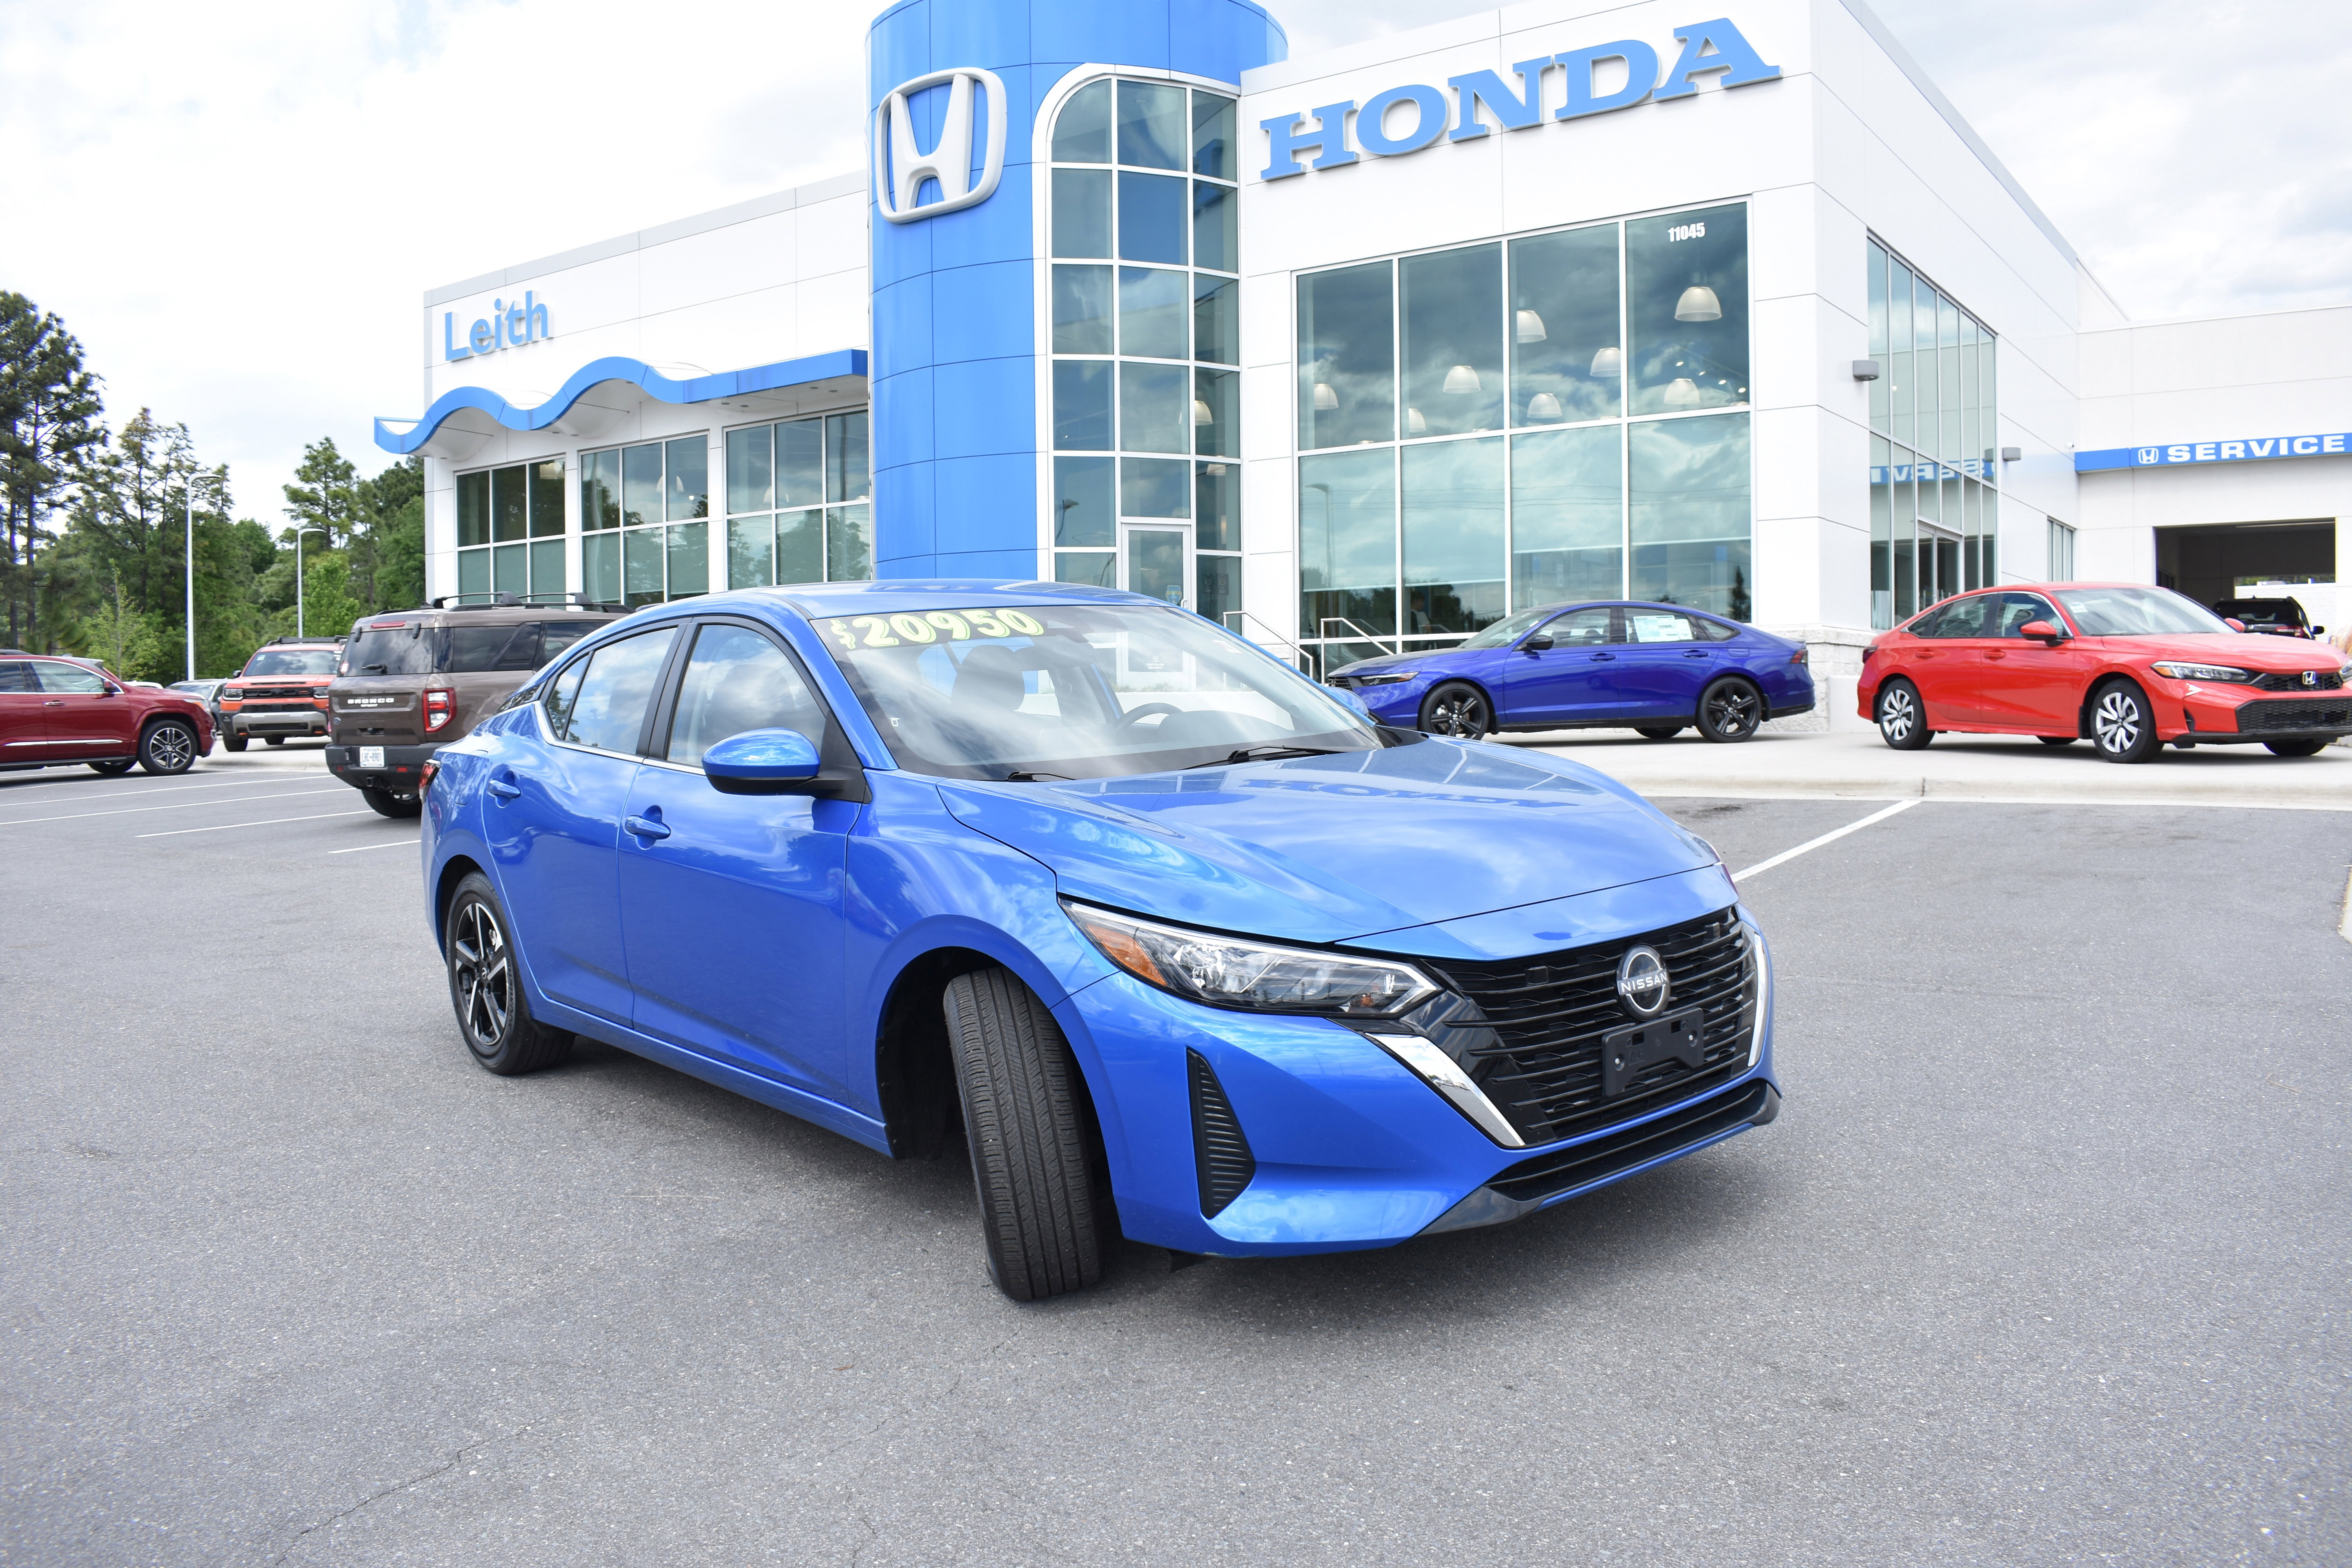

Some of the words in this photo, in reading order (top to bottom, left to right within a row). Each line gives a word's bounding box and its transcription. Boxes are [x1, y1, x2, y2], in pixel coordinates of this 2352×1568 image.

[1260, 17, 1783, 181] HONDA
[1668, 222, 1705, 242] 11045
[445, 290, 552, 362] Leith
[2167, 435, 2345, 462] SERVICE
[830, 609, 1045, 649] $20950
[1621, 971, 1667, 992] NISSAN
